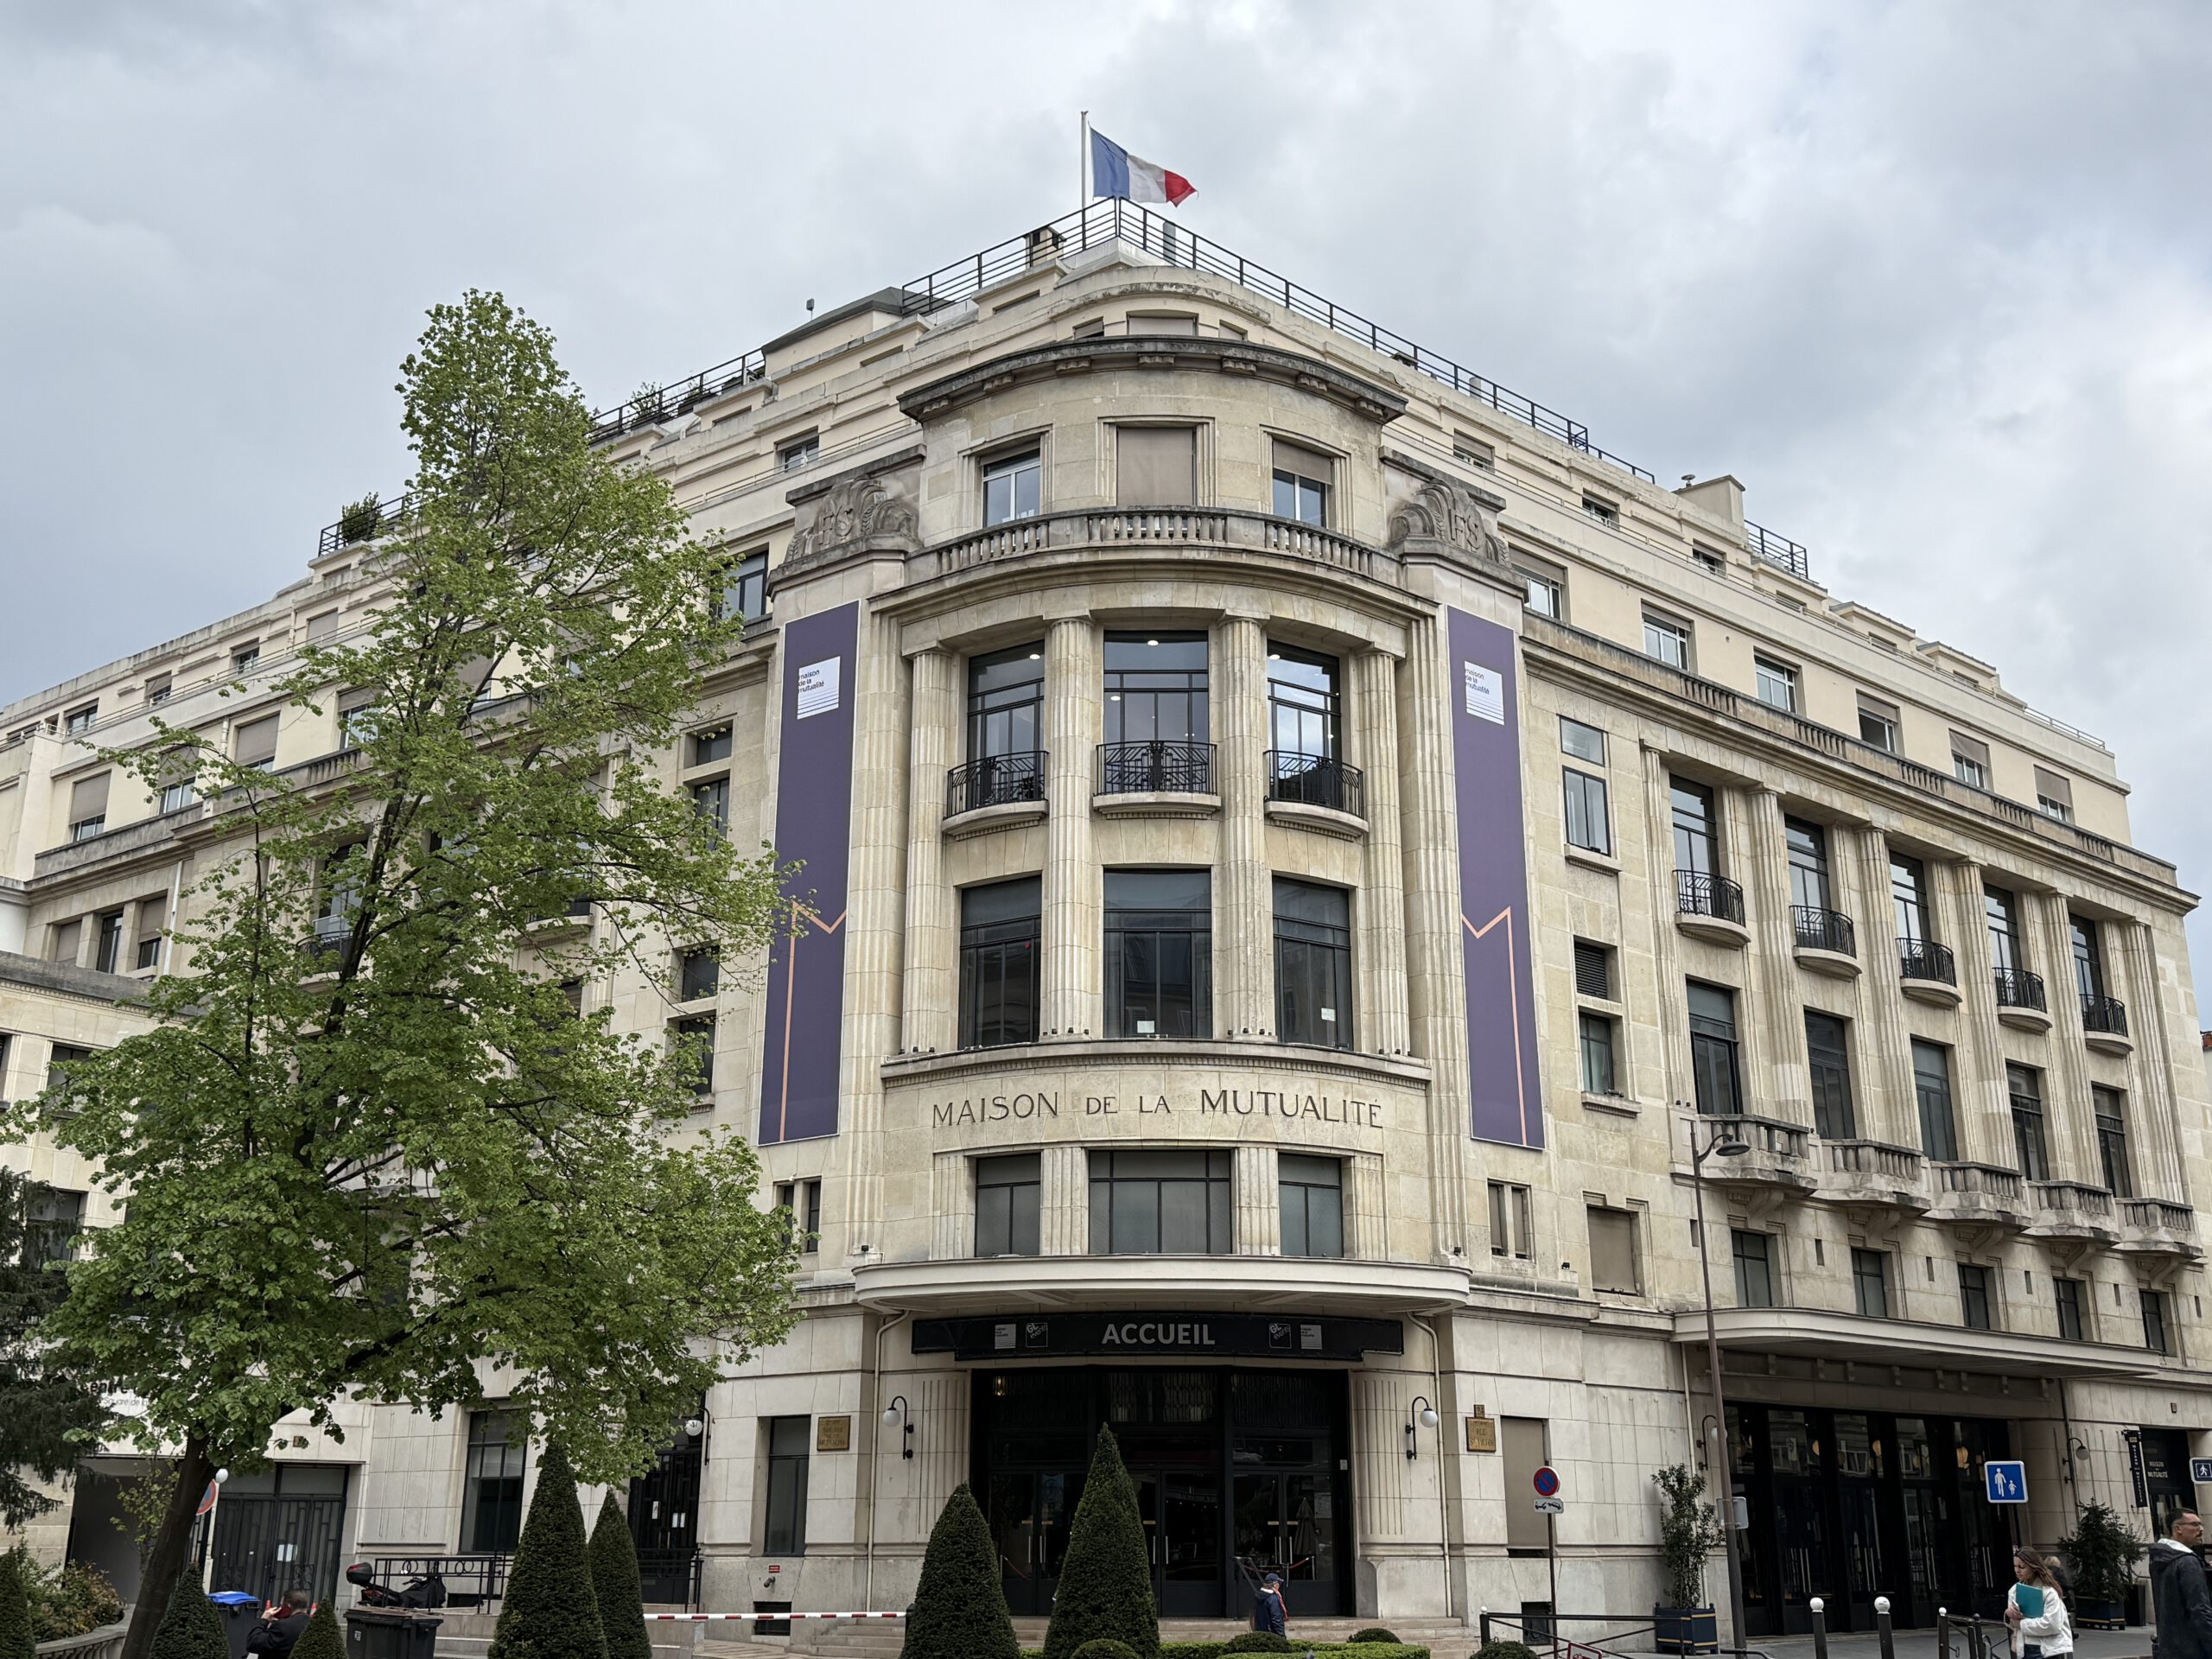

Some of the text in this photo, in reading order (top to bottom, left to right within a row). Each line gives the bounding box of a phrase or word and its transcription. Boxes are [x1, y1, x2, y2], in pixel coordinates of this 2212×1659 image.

[798, 670, 820, 679] maison
[1465, 669, 1484, 680] maison
[932, 1089, 1383, 1128] MAISON DE LA MUTUALITÉ
[1027, 1323, 1039, 1333] GL
[1270, 1323, 1282, 1333] GL
[1101, 1323, 1216, 1345] ACCUEIL
